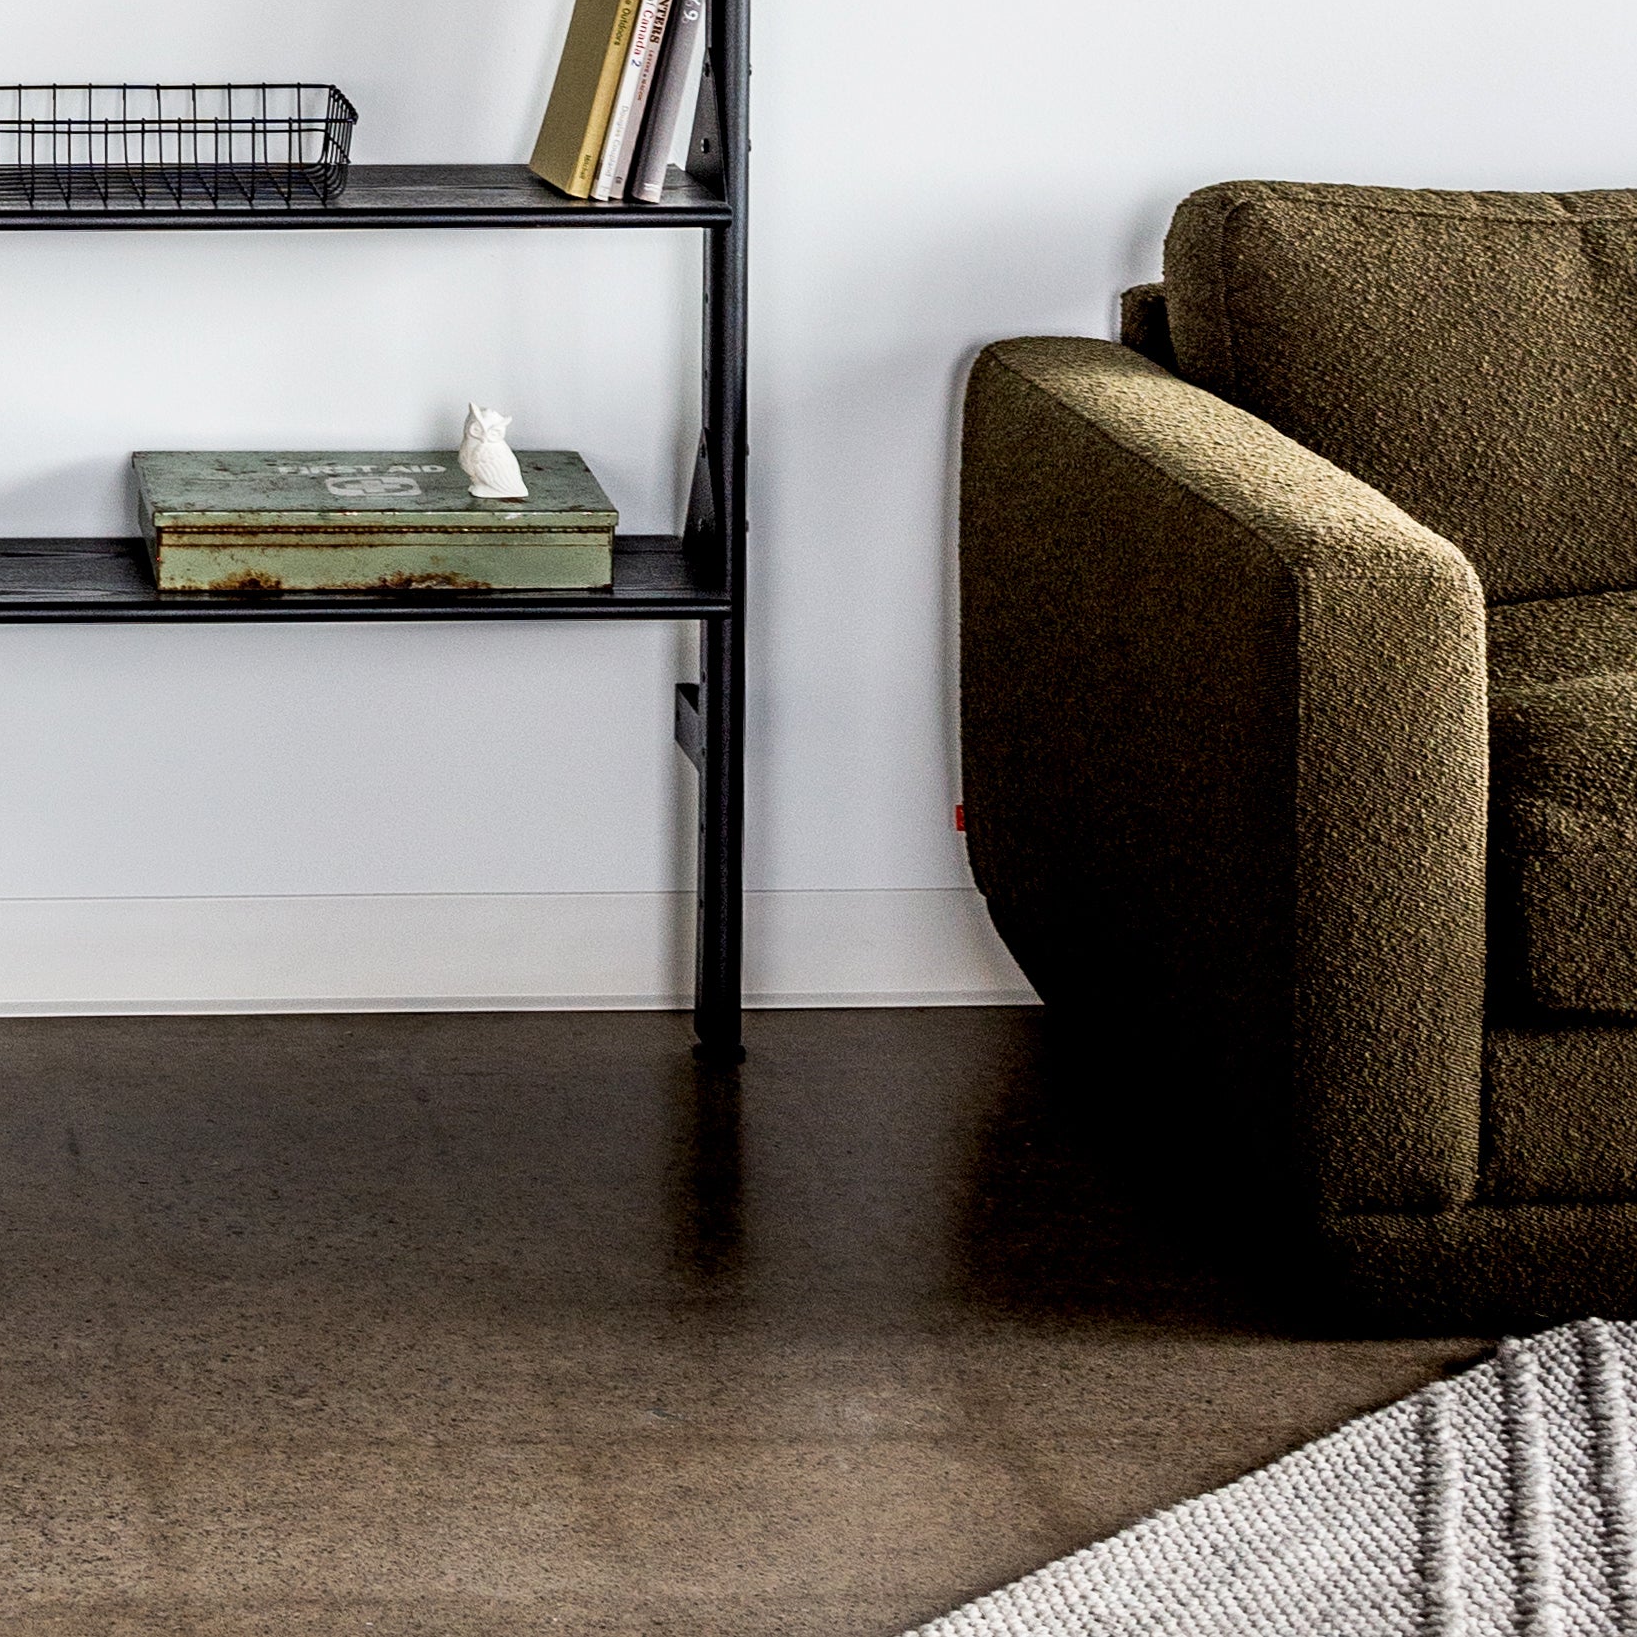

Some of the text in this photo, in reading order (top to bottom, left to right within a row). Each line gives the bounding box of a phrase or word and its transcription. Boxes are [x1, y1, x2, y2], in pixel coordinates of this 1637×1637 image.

[683, 9, 699, 21] 9
[613, 7, 631, 46] Outdoors
[634, 9, 654, 55] Canada
[631, 58, 642, 68] 2
[278, 465, 446, 474] FIRST AID
